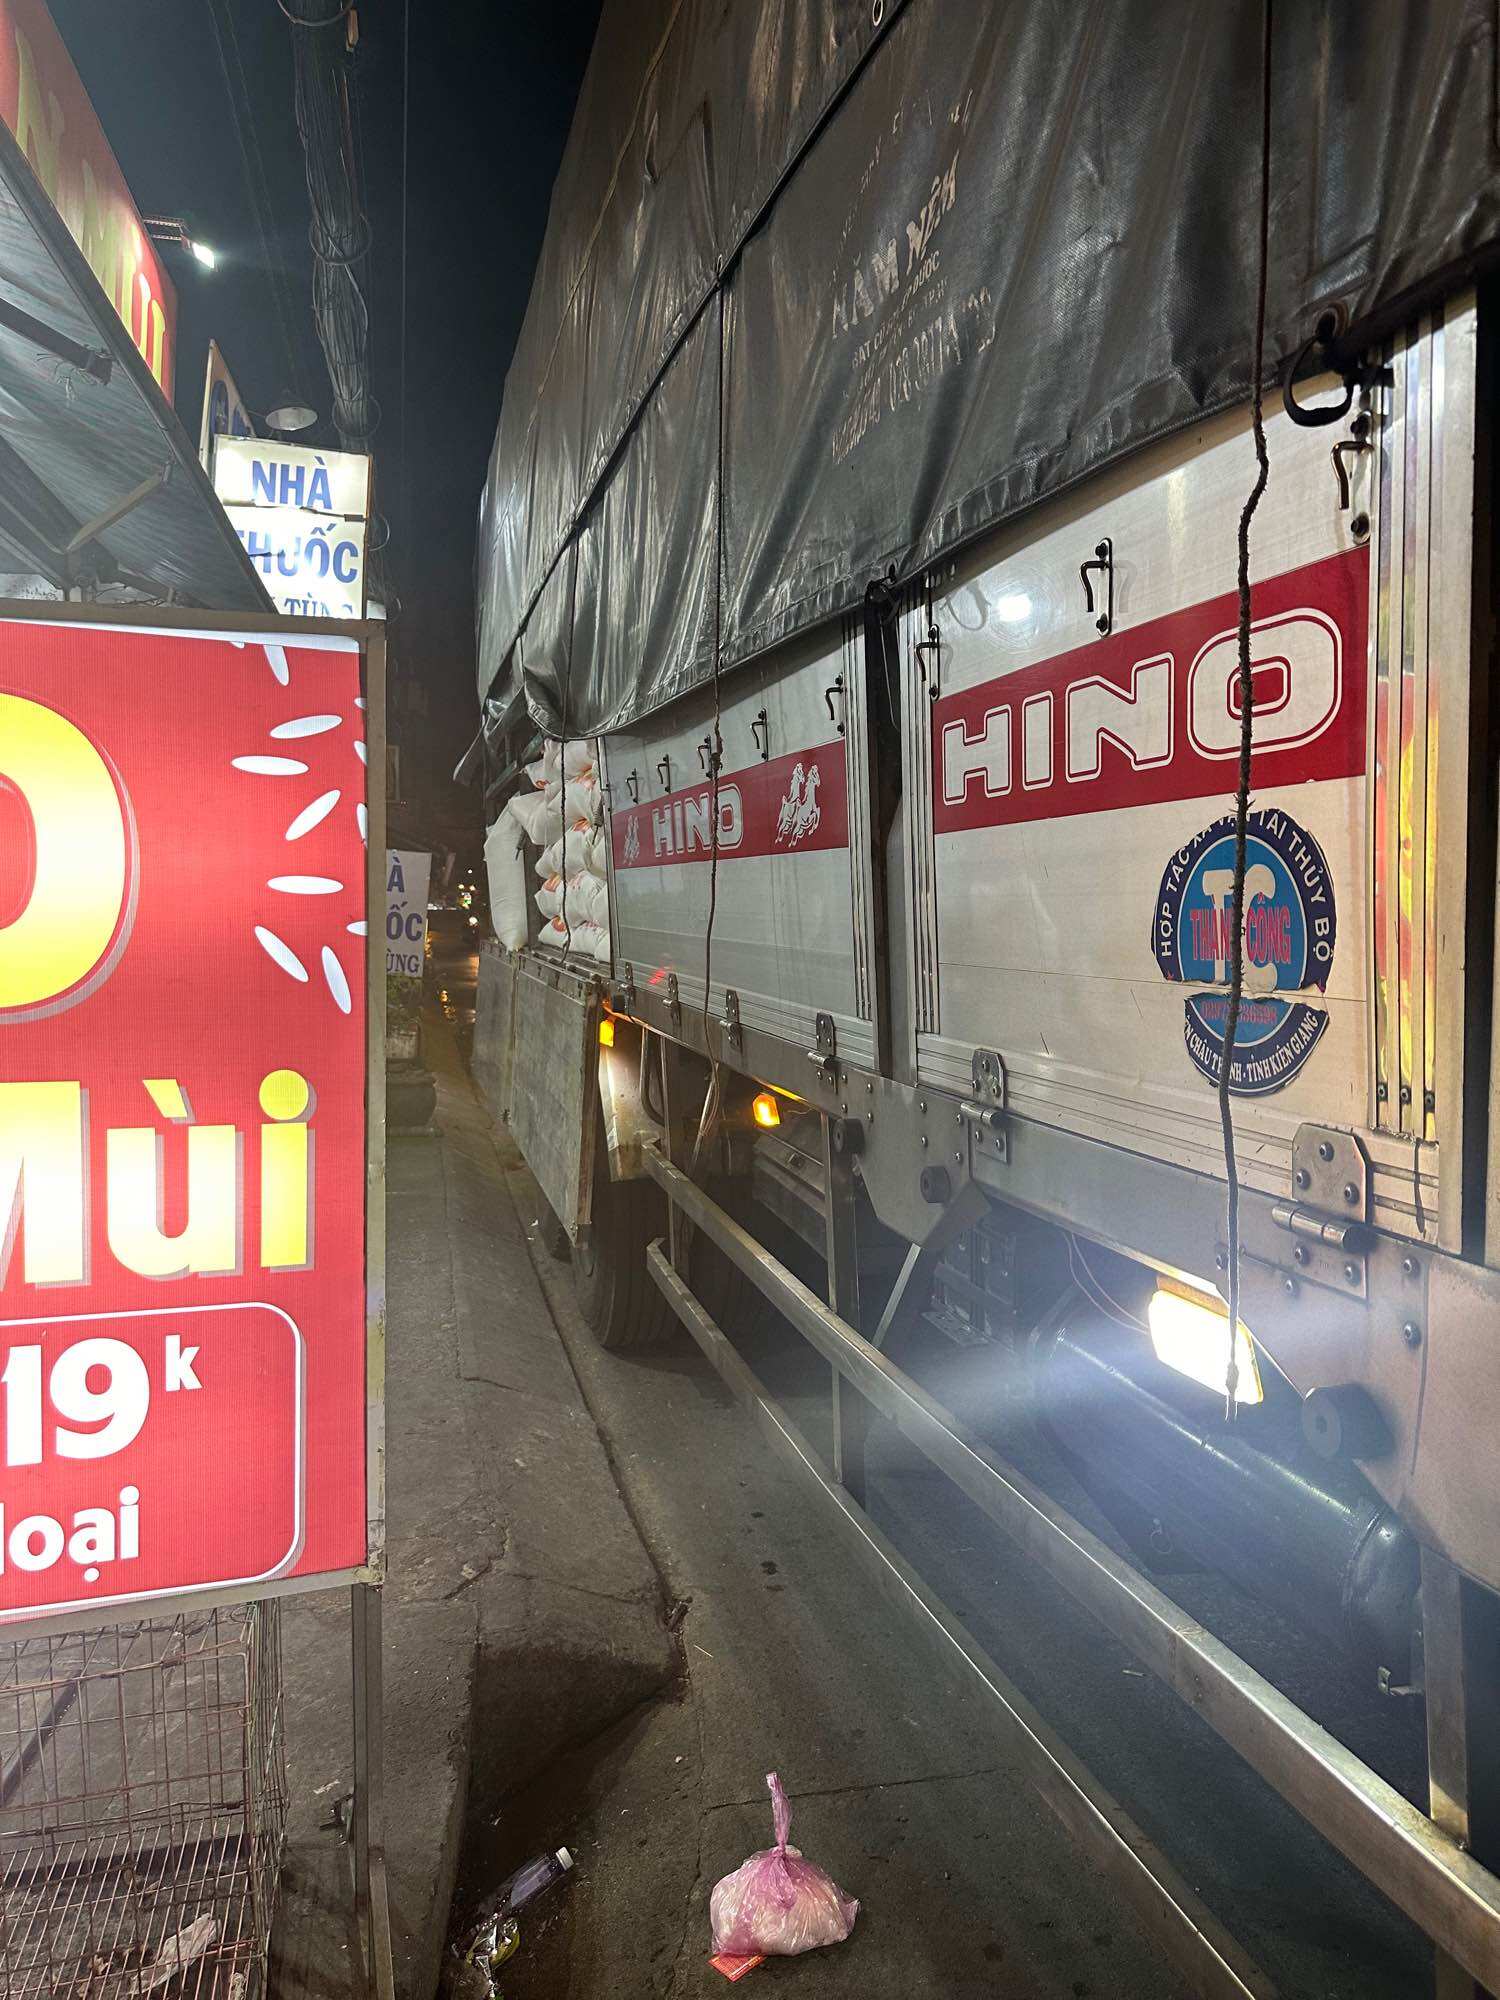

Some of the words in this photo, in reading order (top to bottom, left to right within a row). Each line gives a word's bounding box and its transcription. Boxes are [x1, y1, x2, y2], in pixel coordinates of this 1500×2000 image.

[252, 456, 333, 510] NHÀ
[284, 591, 353, 617] TÙN
[942, 607, 1342, 806] HINO
[651, 783, 744, 858] HINO
[1166, 846, 1190, 893] TÁC
[1288, 831, 1328, 904] THỦY
[1160, 902, 1174, 957] HỢP
[1246, 892, 1292, 965] CÔNG
[1313, 917, 1334, 962] BỘ
[386, 948, 420, 973] ÙNG
[1190, 1033, 1212, 1065] CHÂU
[1211, 1053, 1242, 1082] THNH
[1247, 1054, 1272, 1082] TỈNH
[1270, 1045, 1296, 1076] KIÊN
[1290, 1011, 1319, 1055] GIANG
[0, 1485, 141, 1582] oại
